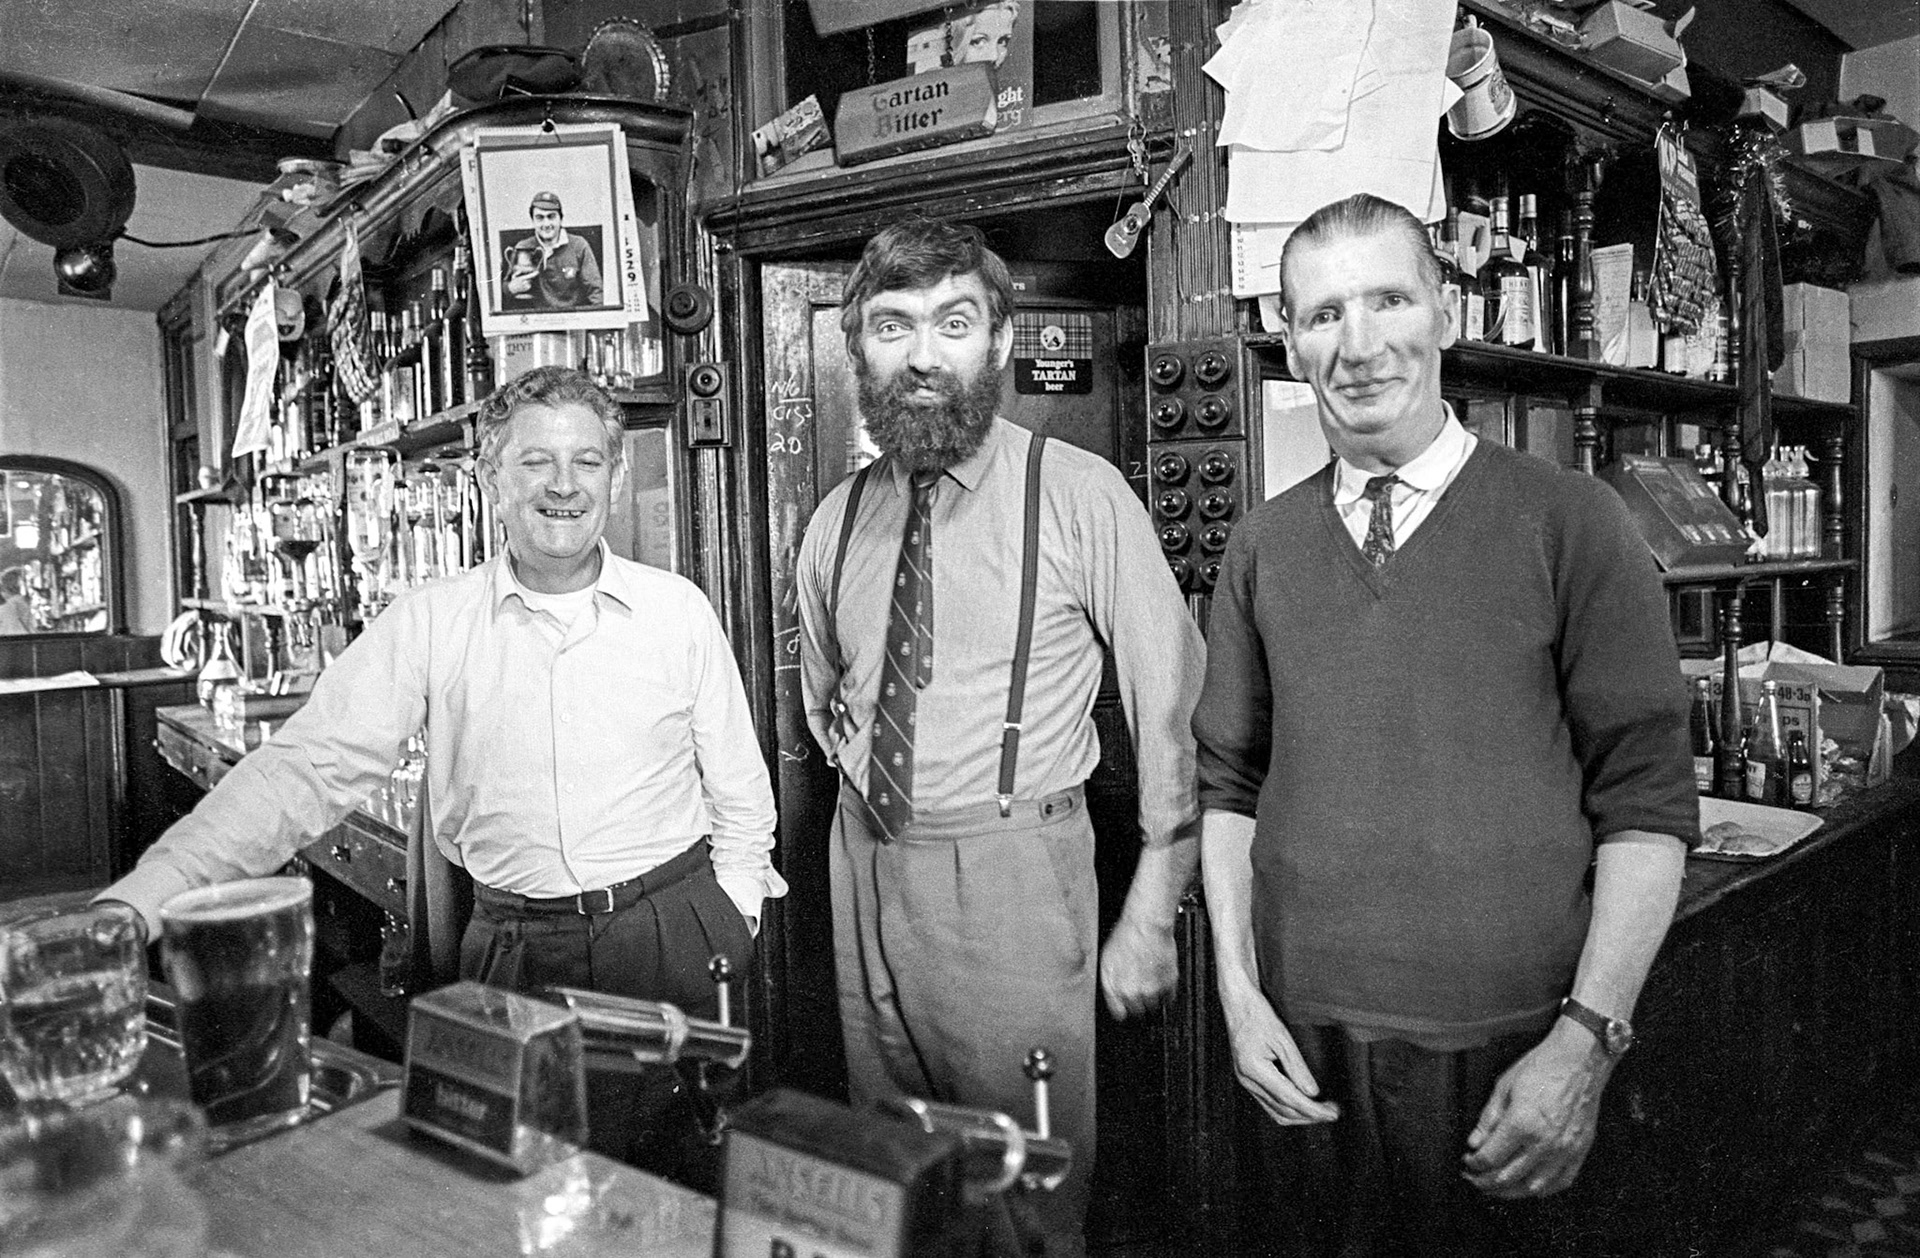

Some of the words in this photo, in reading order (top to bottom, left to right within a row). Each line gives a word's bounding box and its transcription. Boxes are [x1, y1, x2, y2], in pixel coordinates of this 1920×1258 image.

[869, 81, 949, 112] Tartan
[997, 86, 1024, 108] ght
[873, 108, 943, 138] Bitter
[1034, 358, 1074, 370] Younger's
[1031, 370, 1077, 381] TARTAN
[1044, 381, 1064, 391] beer
[770, 432, 802, 455] 20
